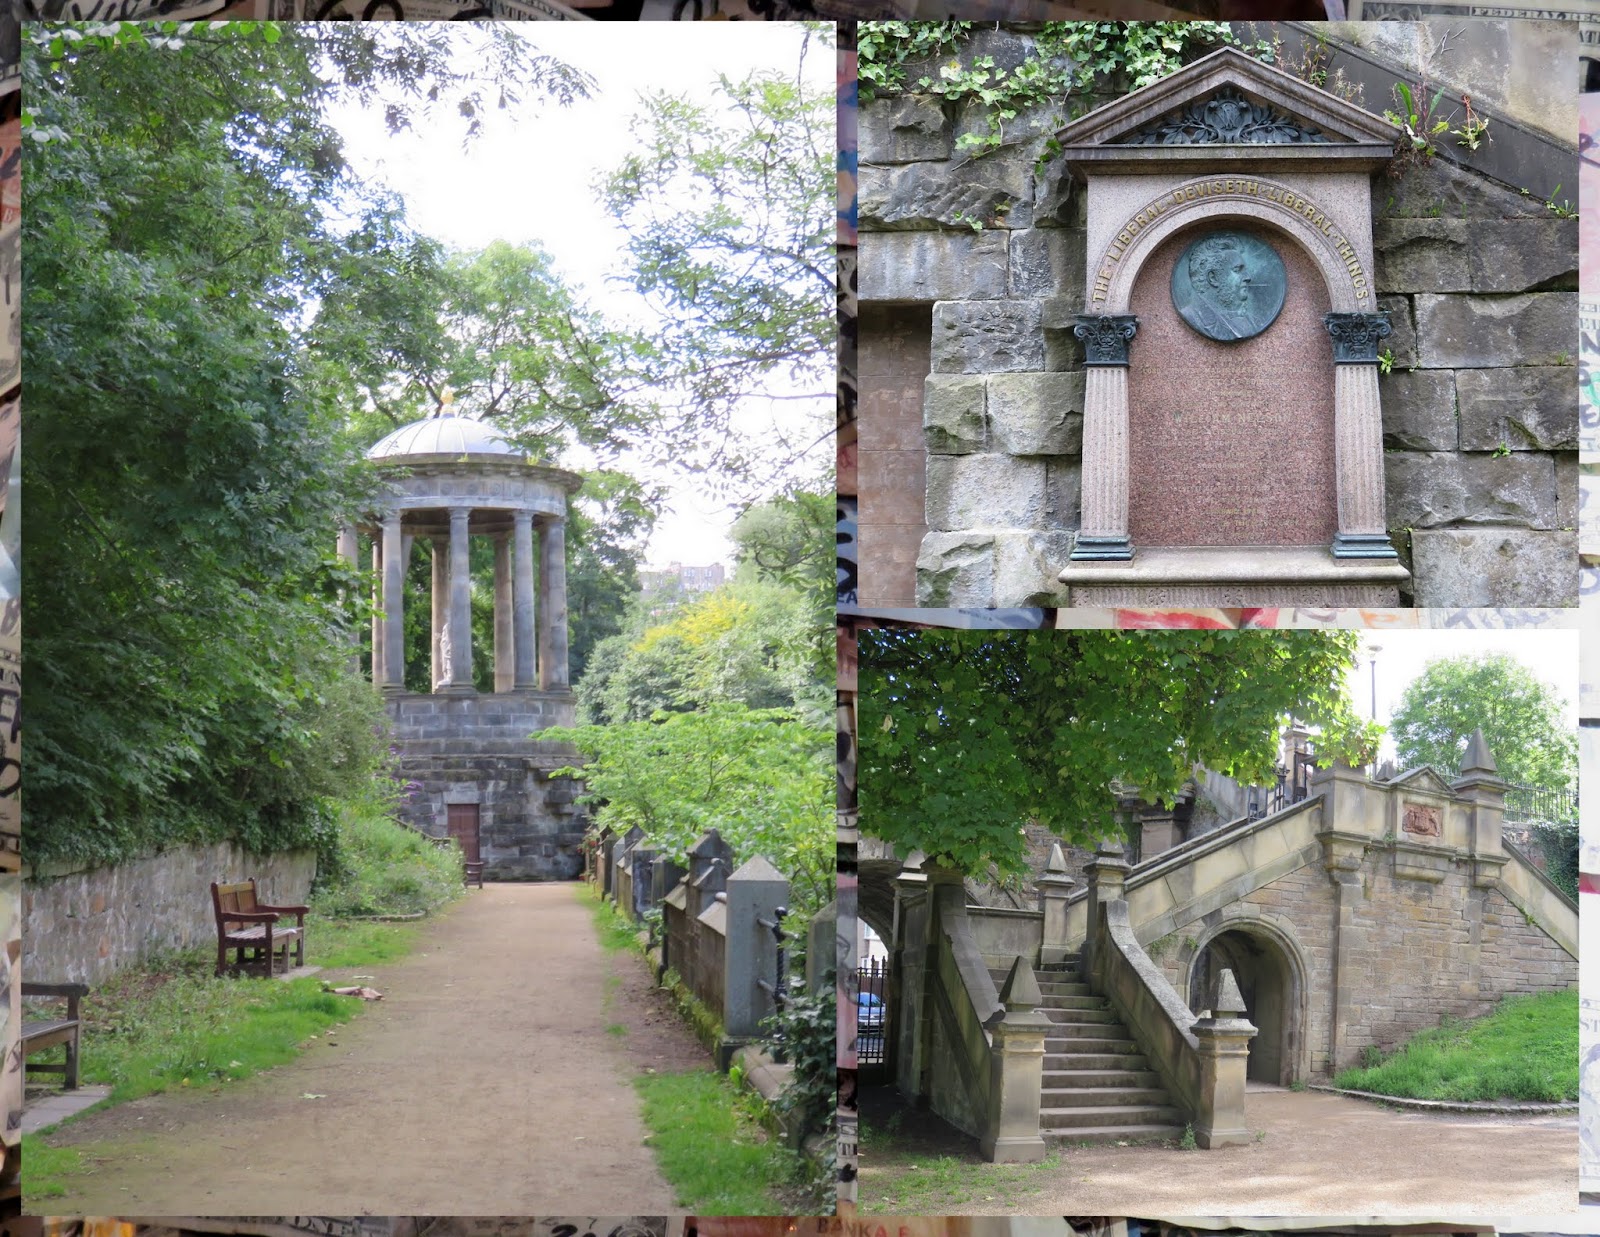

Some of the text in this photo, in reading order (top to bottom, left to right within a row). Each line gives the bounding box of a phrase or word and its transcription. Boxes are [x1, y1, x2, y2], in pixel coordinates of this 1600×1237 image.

[1473, 7, 1560, 20] FEDERAL
[1092, 180, 1369, 302] THE LIBERAL DEVISETH LIBERAL THINGS
